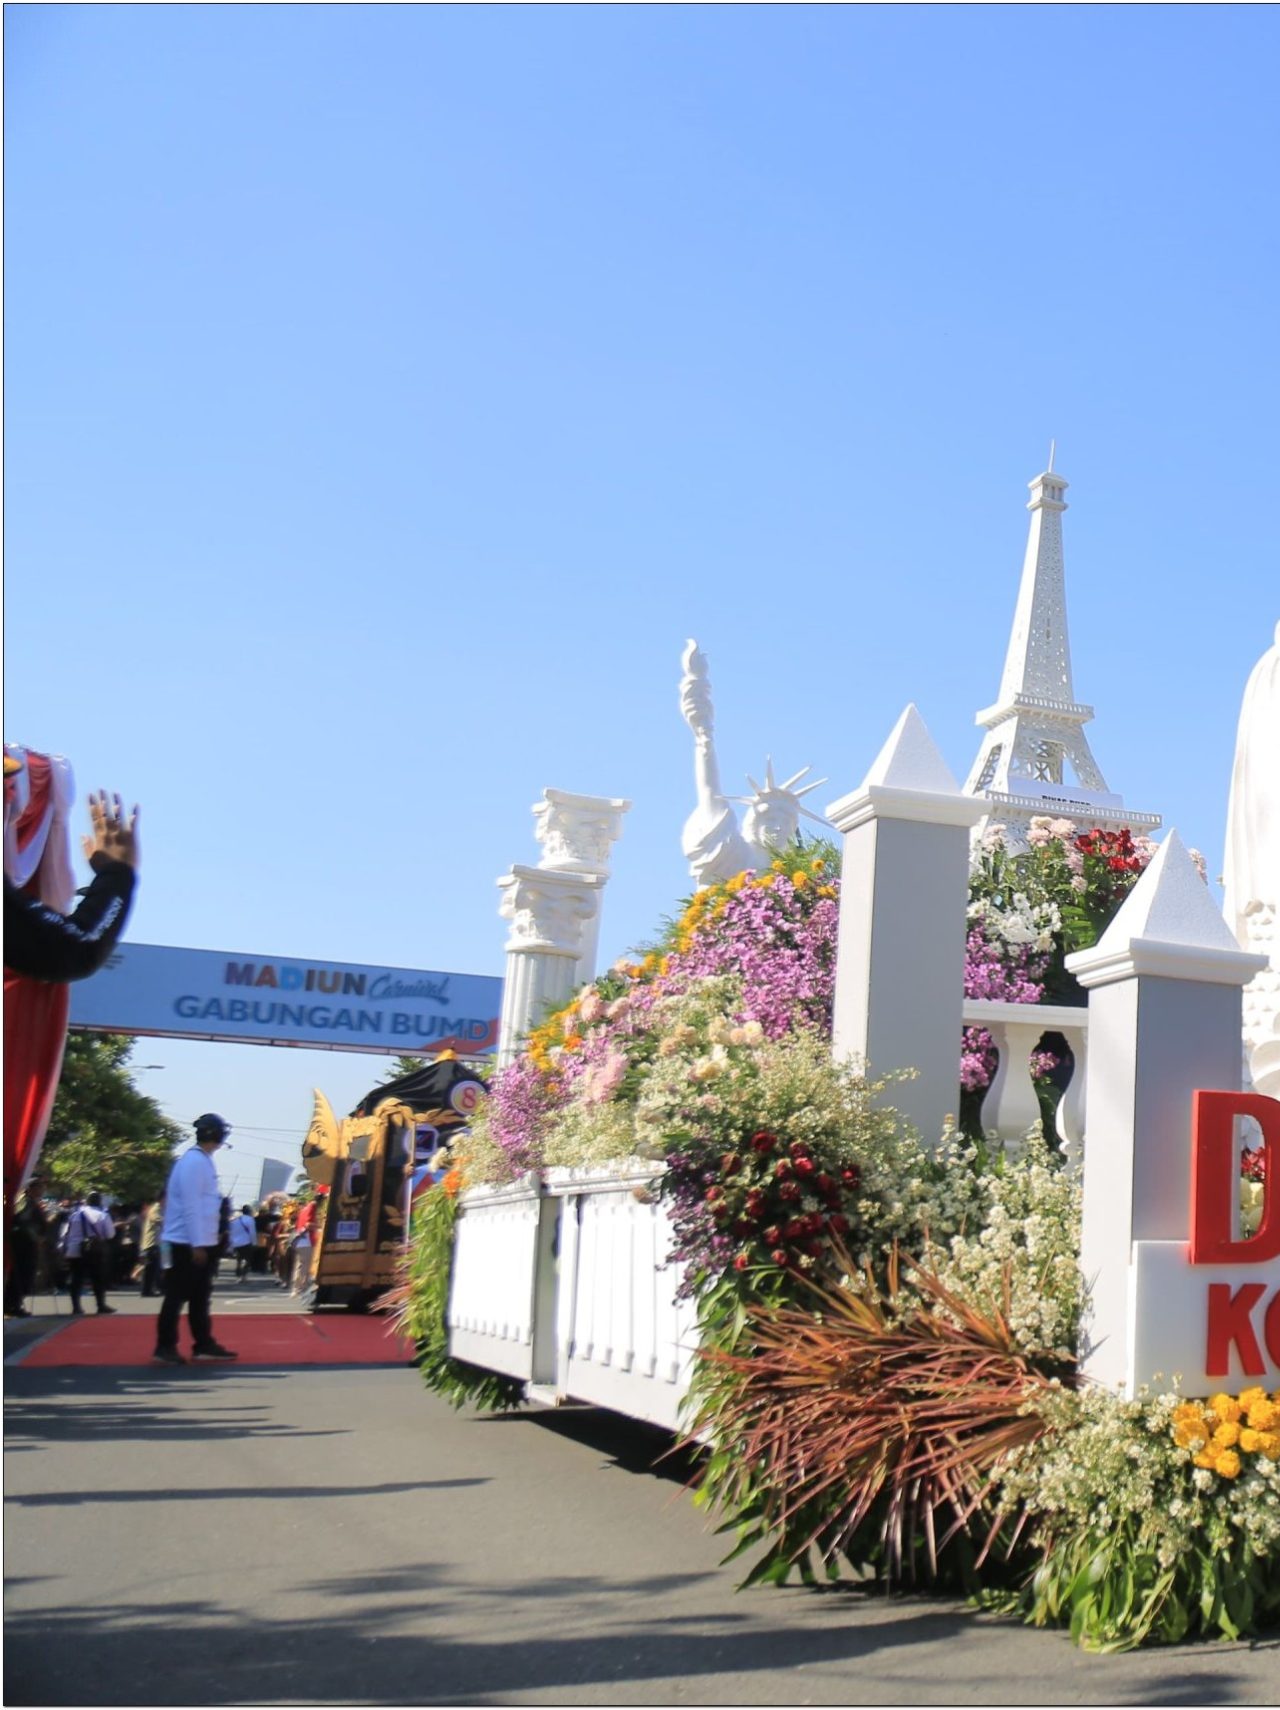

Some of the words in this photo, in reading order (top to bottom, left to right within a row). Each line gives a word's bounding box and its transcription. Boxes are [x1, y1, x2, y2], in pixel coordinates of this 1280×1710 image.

[224, 961, 366, 996] MADIUN
[368, 973, 450, 1006] Carnival
[174, 995, 382, 1032] GABUNGAN
[390, 1013, 489, 1041] BUMD
[461, 1086, 477, 1110] 8
